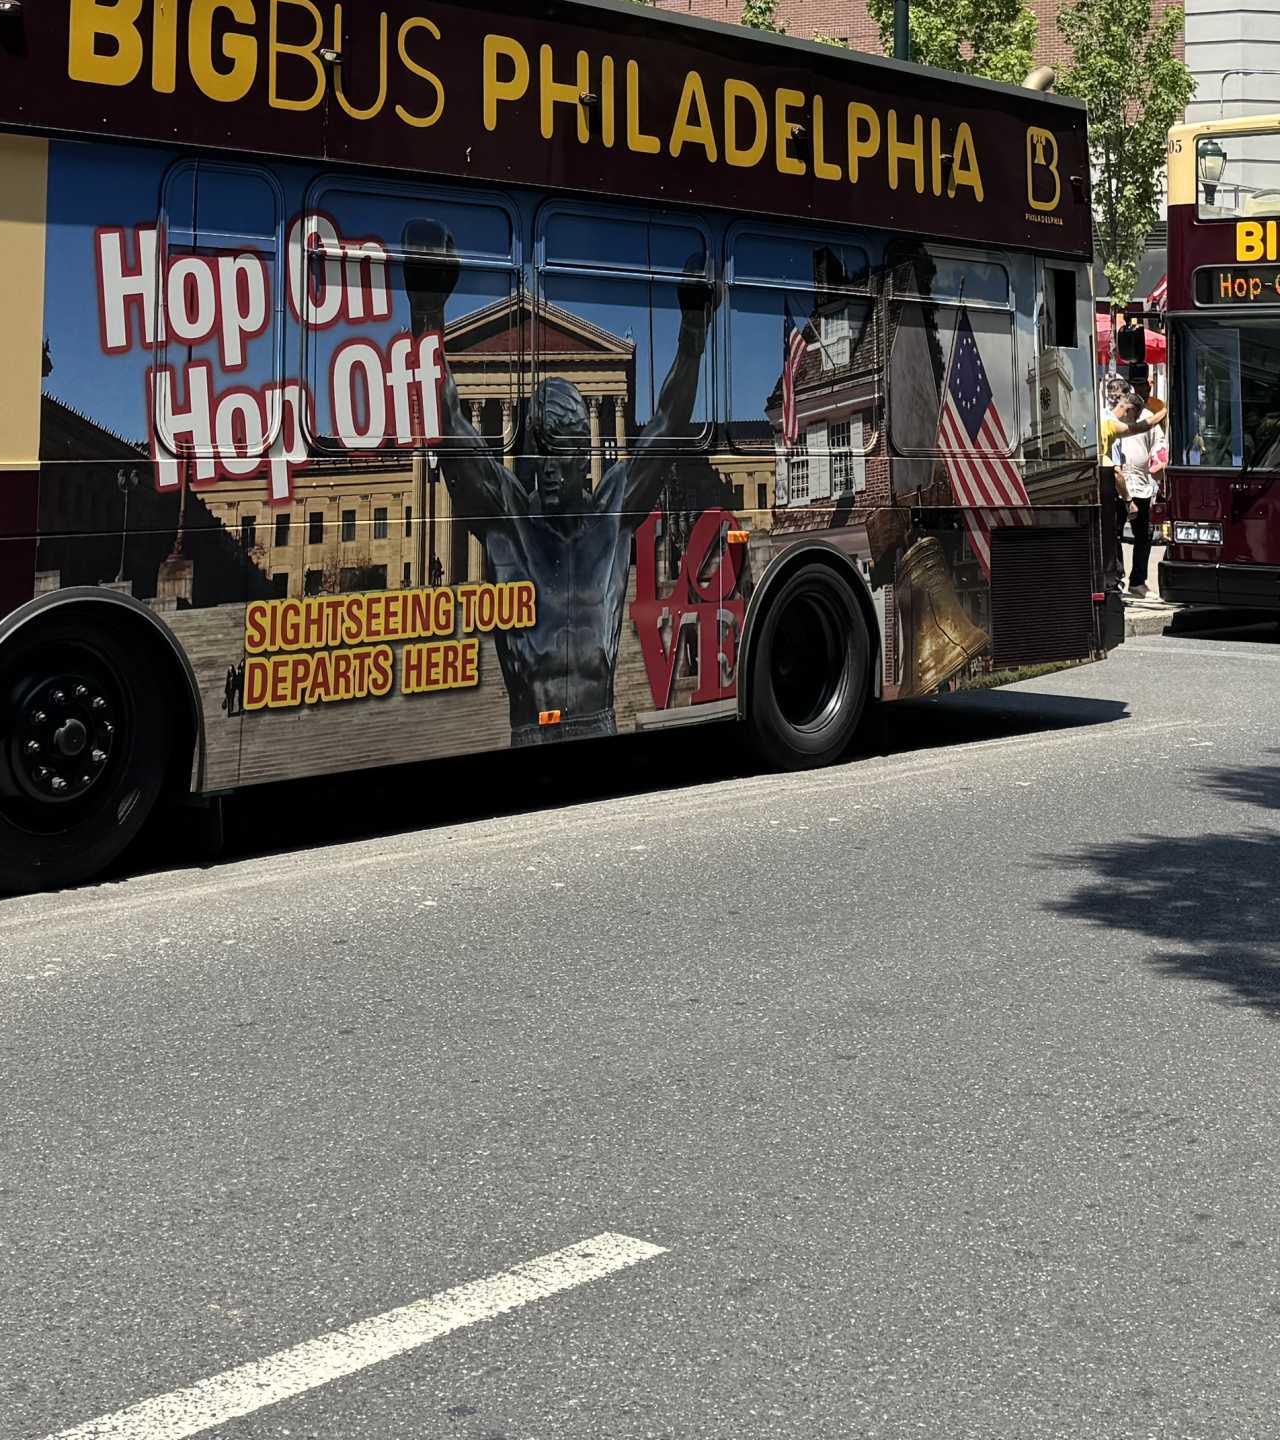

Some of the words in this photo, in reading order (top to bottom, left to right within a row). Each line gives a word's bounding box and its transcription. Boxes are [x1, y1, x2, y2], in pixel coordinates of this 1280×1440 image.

[482, 34, 984, 203] PHILADELPHIA
[1024, 212, 1064, 226] PHILADELPHIA
[98, 228, 267, 368] Hop
[287, 214, 388, 325] On
[150, 364, 310, 501] Hop
[333, 334, 444, 450] Off
[246, 589, 453, 649] SIGHTSEEING
[459, 582, 535, 628] TOUR
[245, 648, 390, 706] DEPARTS
[403, 642, 478, 689] HERE
